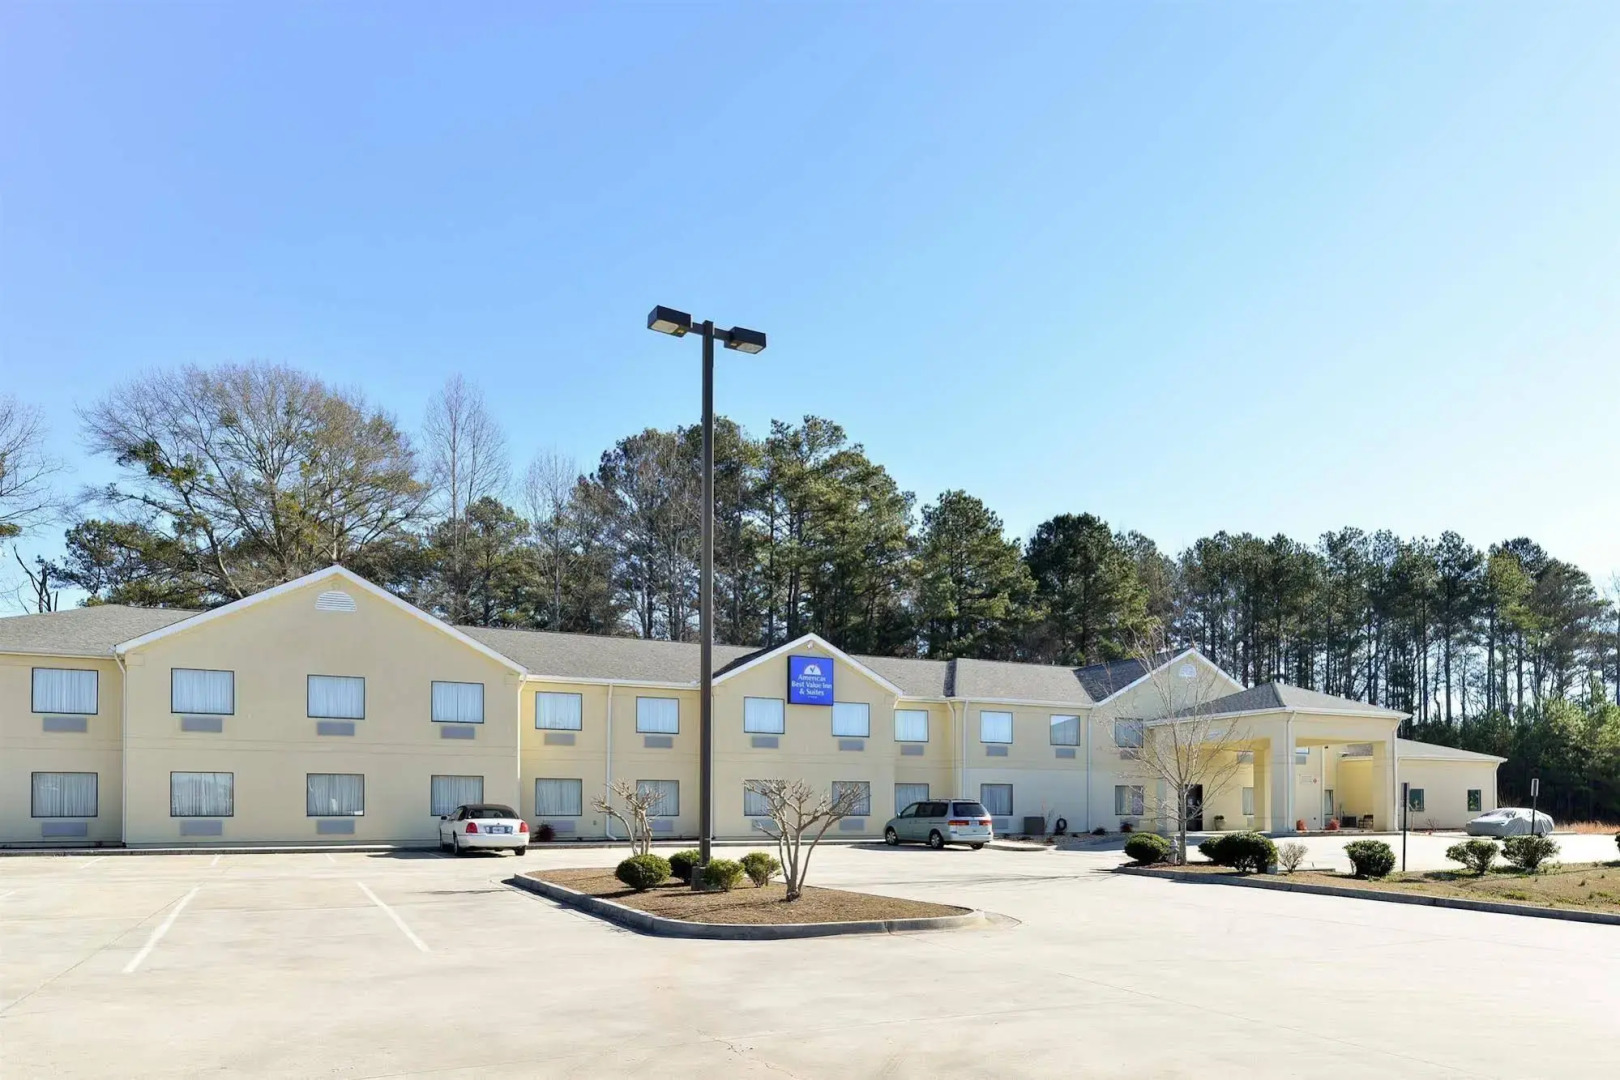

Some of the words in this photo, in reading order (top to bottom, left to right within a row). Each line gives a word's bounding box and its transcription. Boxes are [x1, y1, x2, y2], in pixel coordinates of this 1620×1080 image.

[791, 680, 805, 688] Best
[805, 681, 822, 689] Value
[806, 688, 825, 696] Suites
